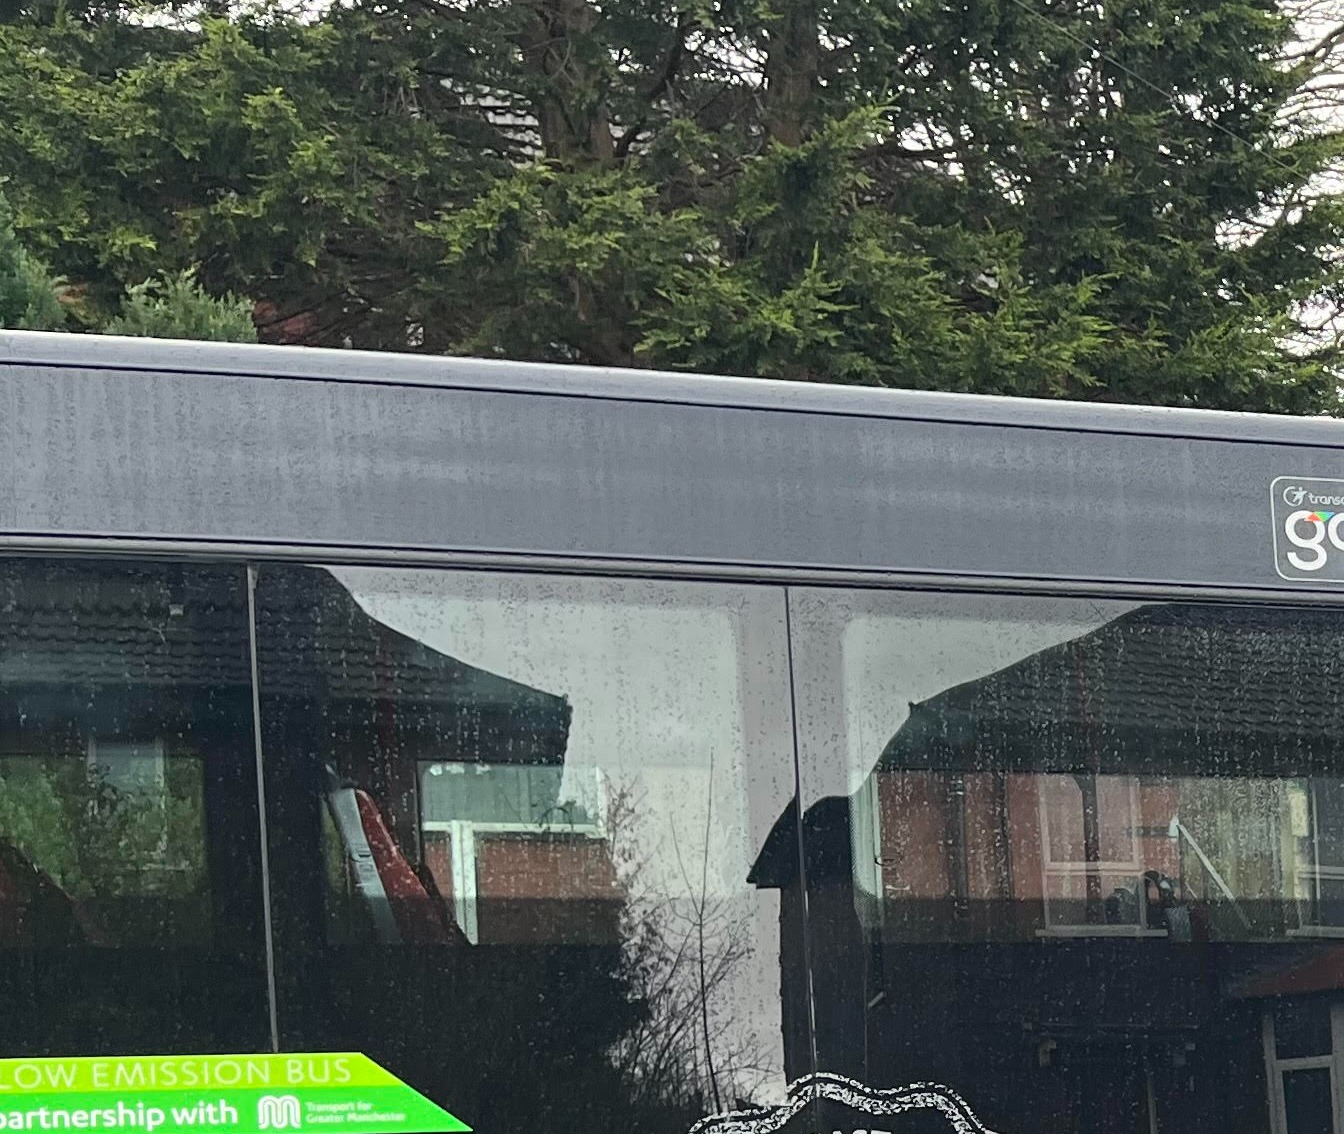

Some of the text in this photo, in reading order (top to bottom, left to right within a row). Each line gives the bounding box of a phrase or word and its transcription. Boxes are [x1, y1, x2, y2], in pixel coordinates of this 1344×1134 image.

[92, 1060, 270, 1088] EMISSION
[286, 1058, 351, 1084] BUS
[171, 1099, 239, 1125] with
